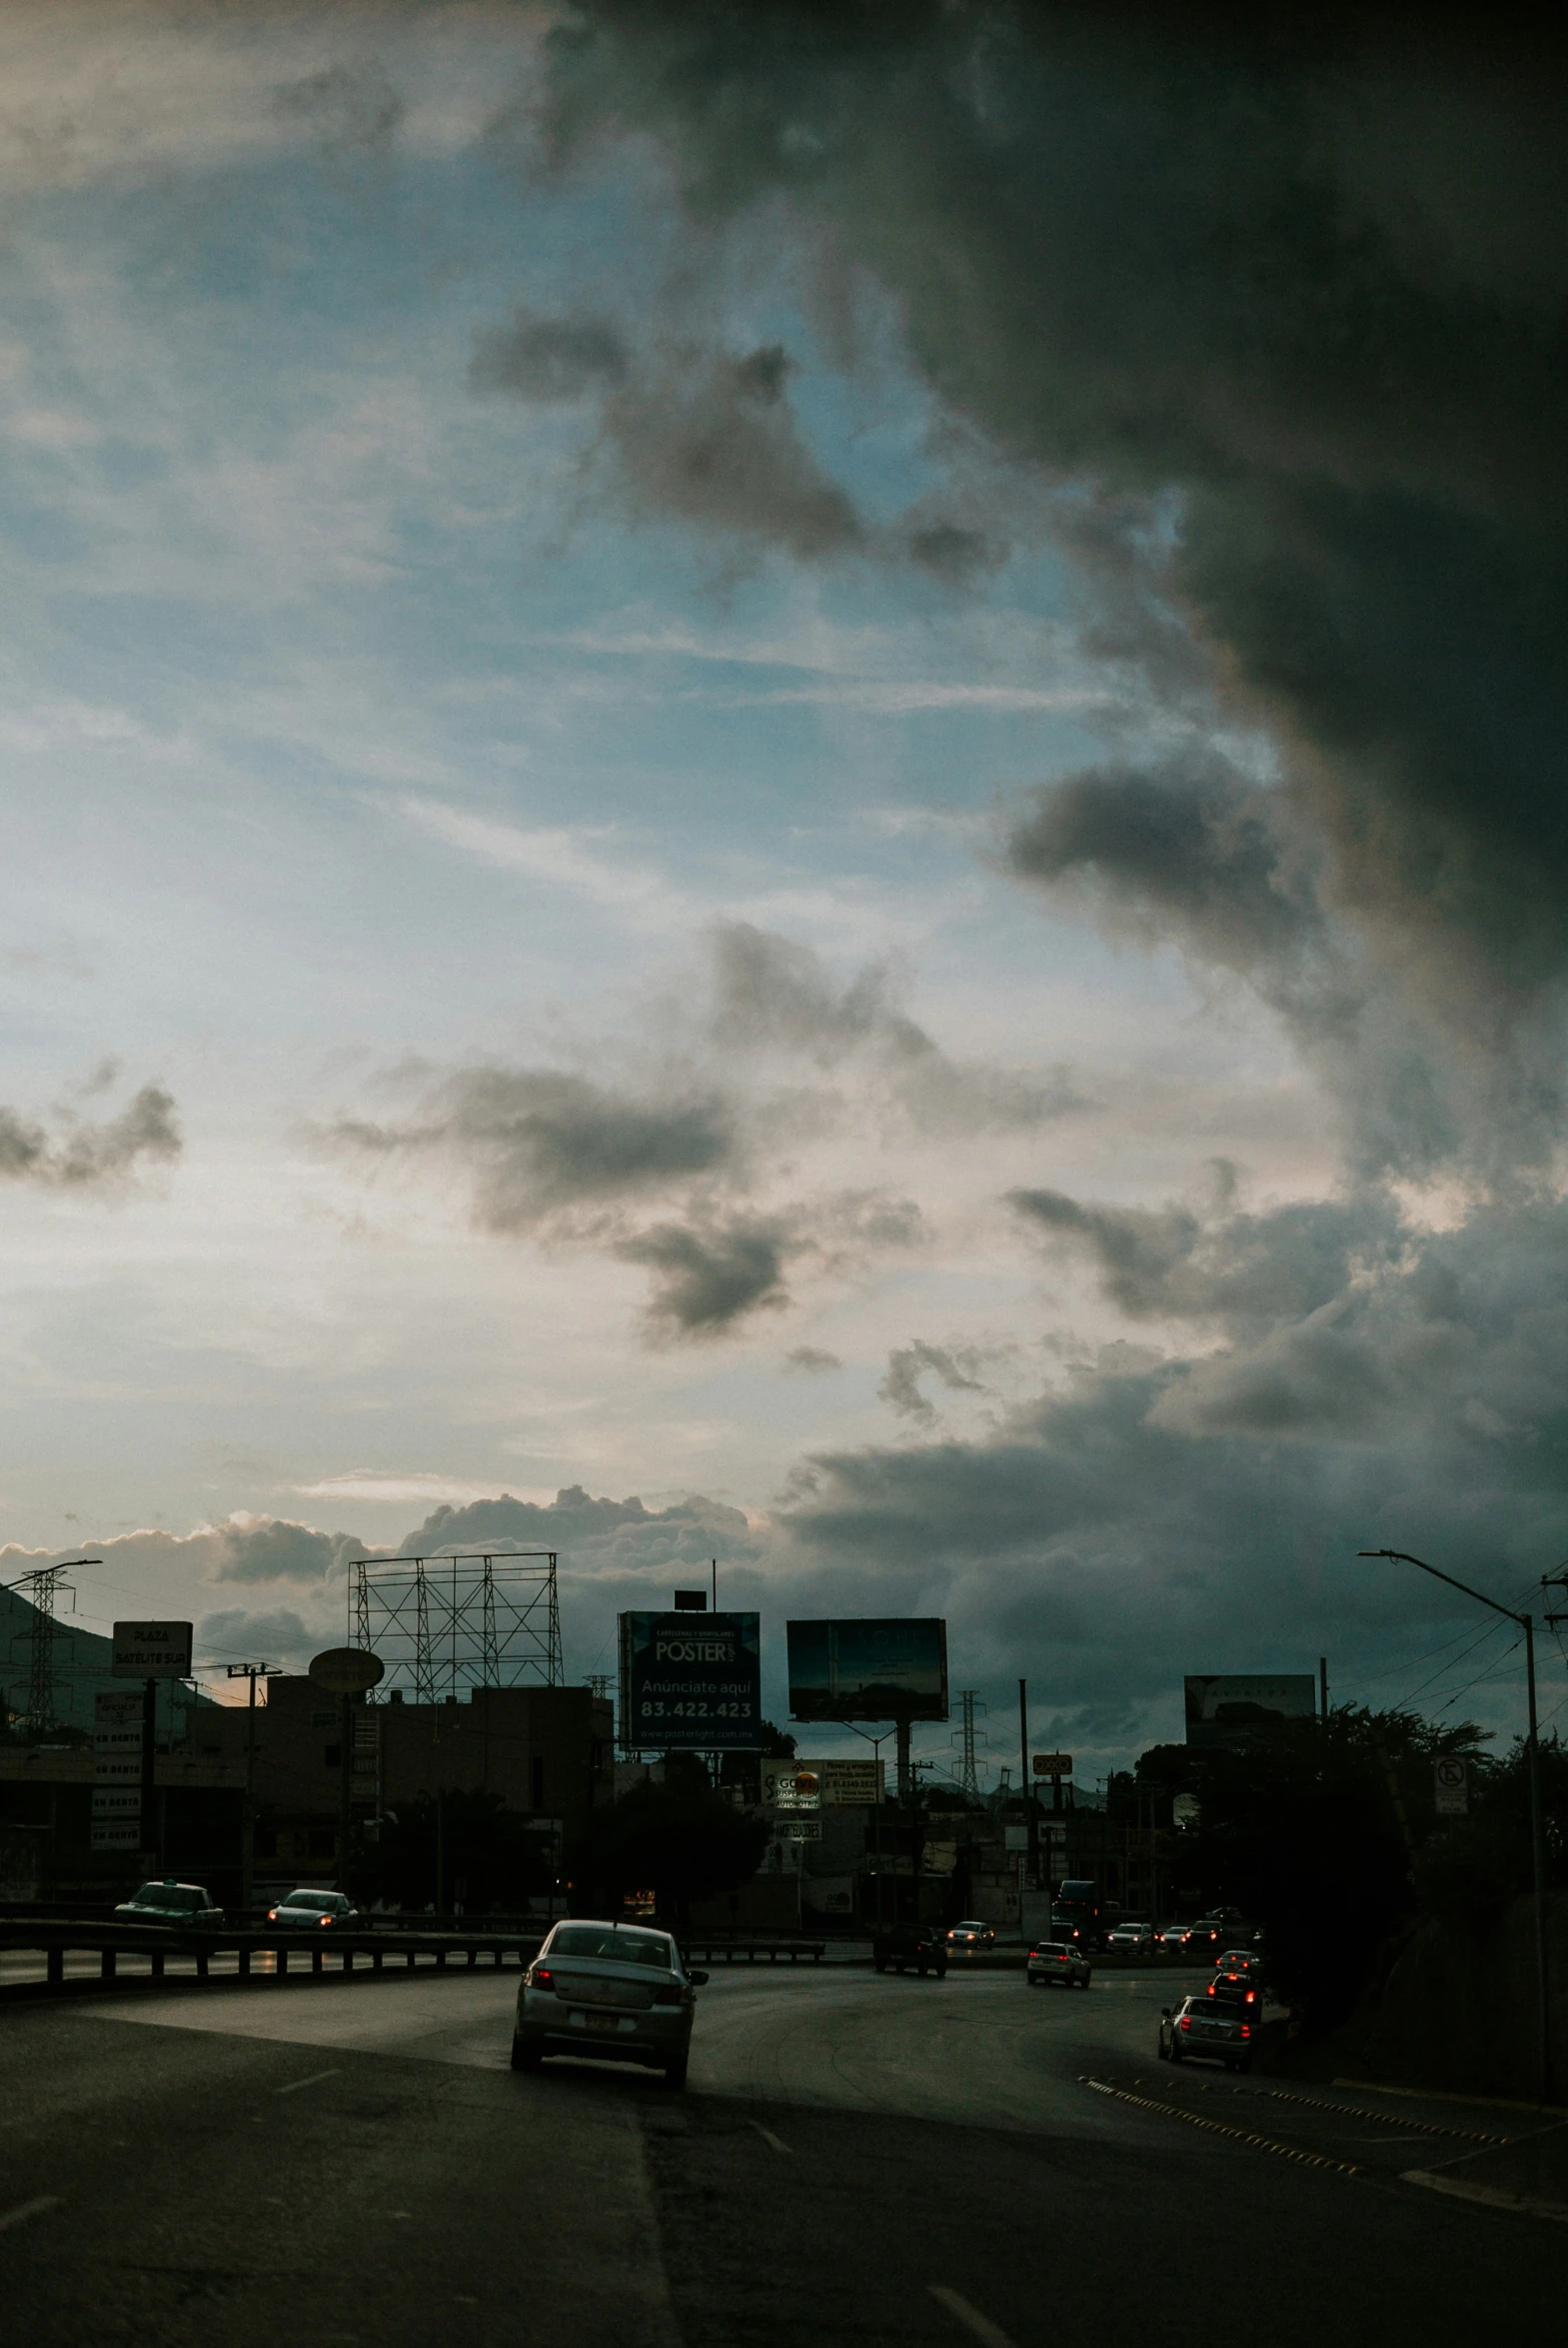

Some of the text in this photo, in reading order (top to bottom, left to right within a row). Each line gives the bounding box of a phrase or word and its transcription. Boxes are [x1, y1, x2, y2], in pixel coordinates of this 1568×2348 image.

[134, 1630, 169, 1641] PLAZA
[115, 1650, 185, 1664] SATÉLITE SUR
[656, 1641, 727, 1662] POSTER
[642, 1679, 752, 1696] Anúnciate aquí
[641, 1701, 752, 1717] 83.422.423
[640, 1728, 754, 1740] www.posterlight.com.mx
[1034, 1758, 1069, 1770] OXXO
[780, 1778, 812, 1788] GOVI
